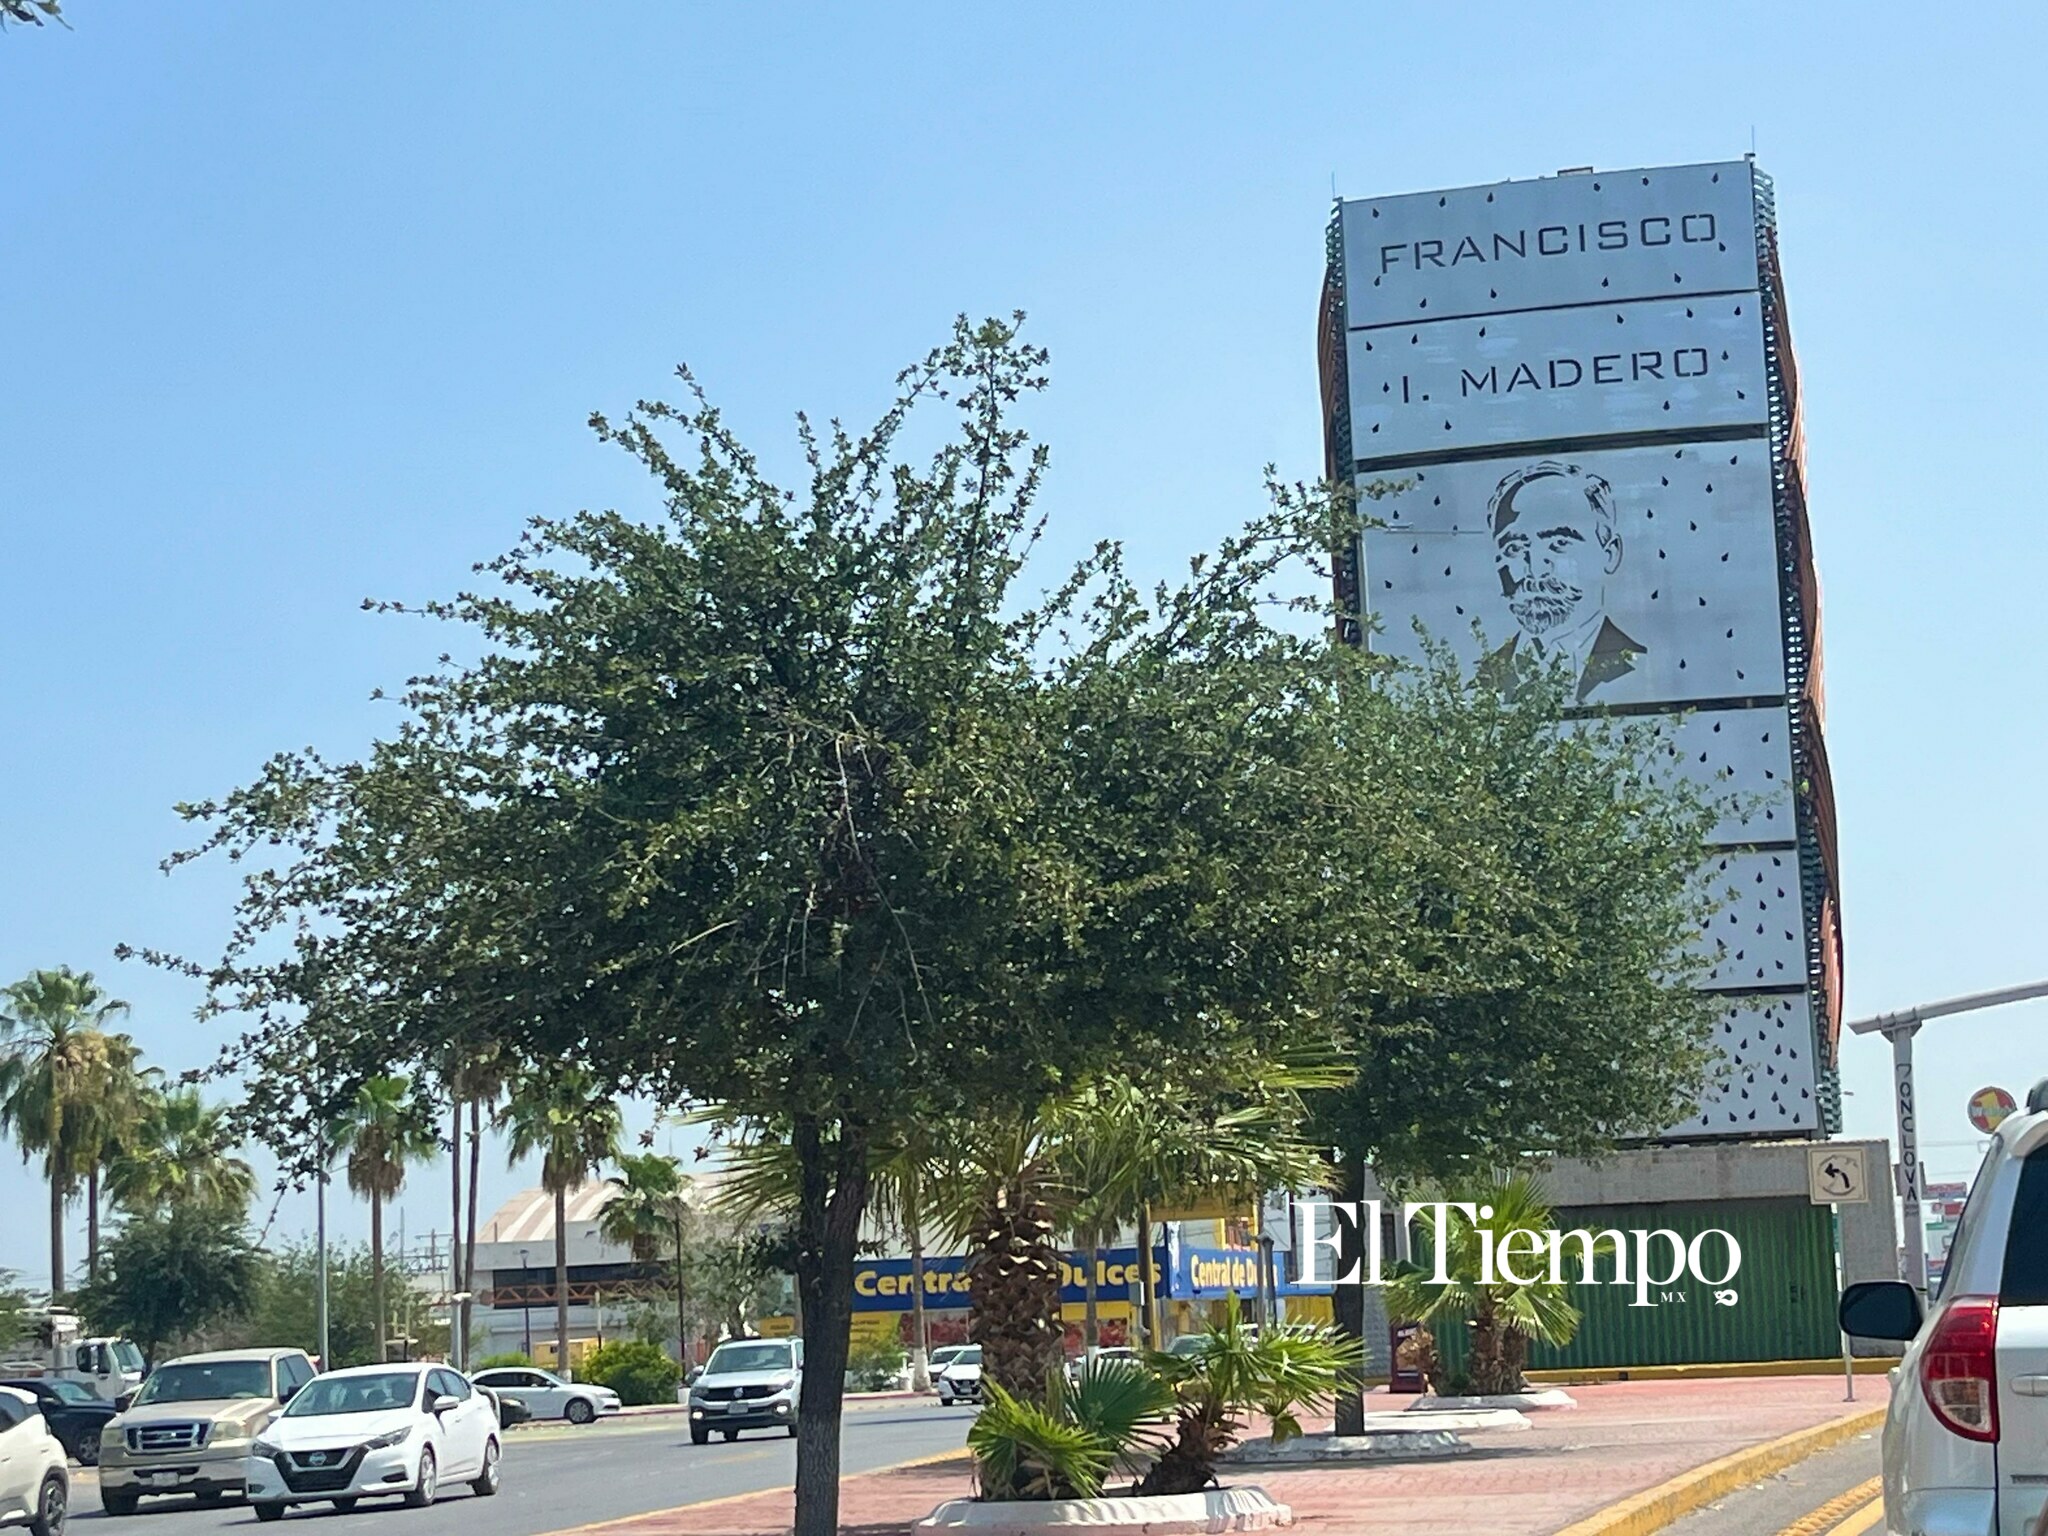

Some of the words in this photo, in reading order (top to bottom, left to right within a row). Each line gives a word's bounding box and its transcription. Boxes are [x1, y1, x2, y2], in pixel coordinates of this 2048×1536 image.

[1380, 213, 1716, 275] FRANCISCO
[1401, 375, 1431, 404] I.
[1460, 347, 1709, 397] MADERO
[854, 1270, 973, 1297] Centra
[1191, 1254, 1231, 1288] Central
[1231, 1256, 1246, 1288] de
